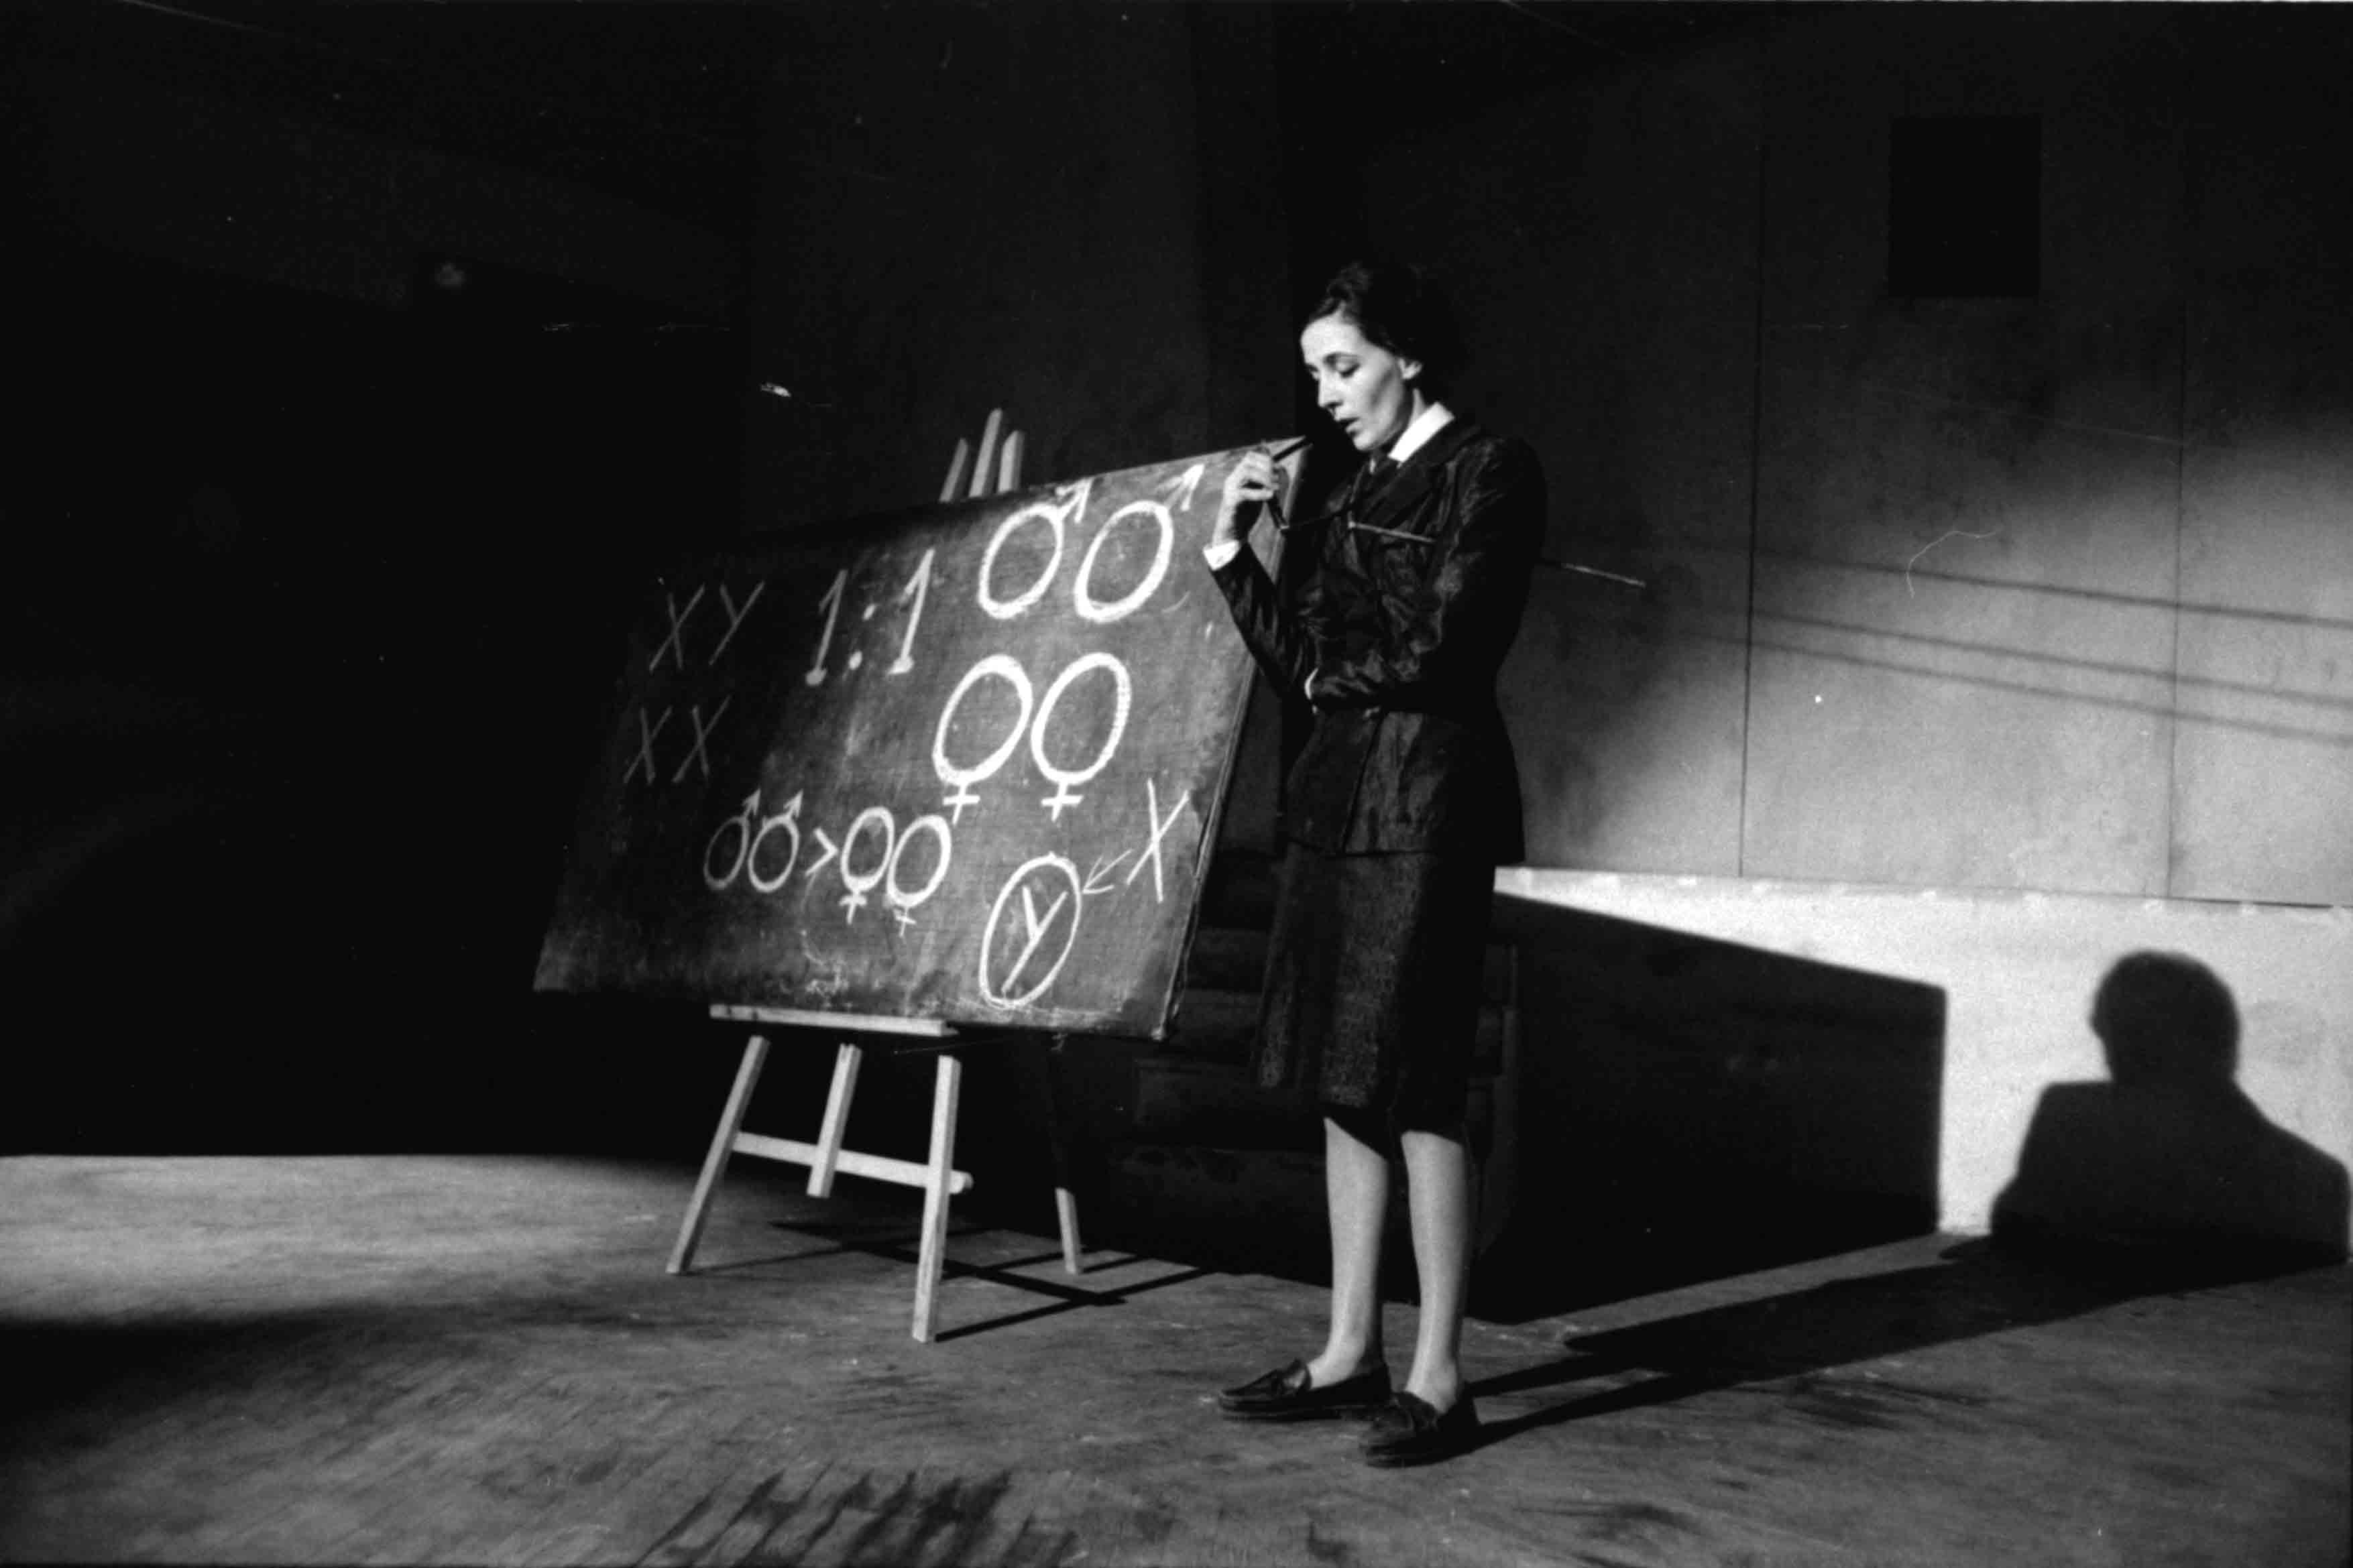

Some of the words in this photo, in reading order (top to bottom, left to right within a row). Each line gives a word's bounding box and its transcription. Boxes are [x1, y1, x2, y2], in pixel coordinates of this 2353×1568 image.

[805, 548, 935, 686] 1:1
[1127, 778, 1190, 903] X
[1002, 886, 1068, 993] Y
